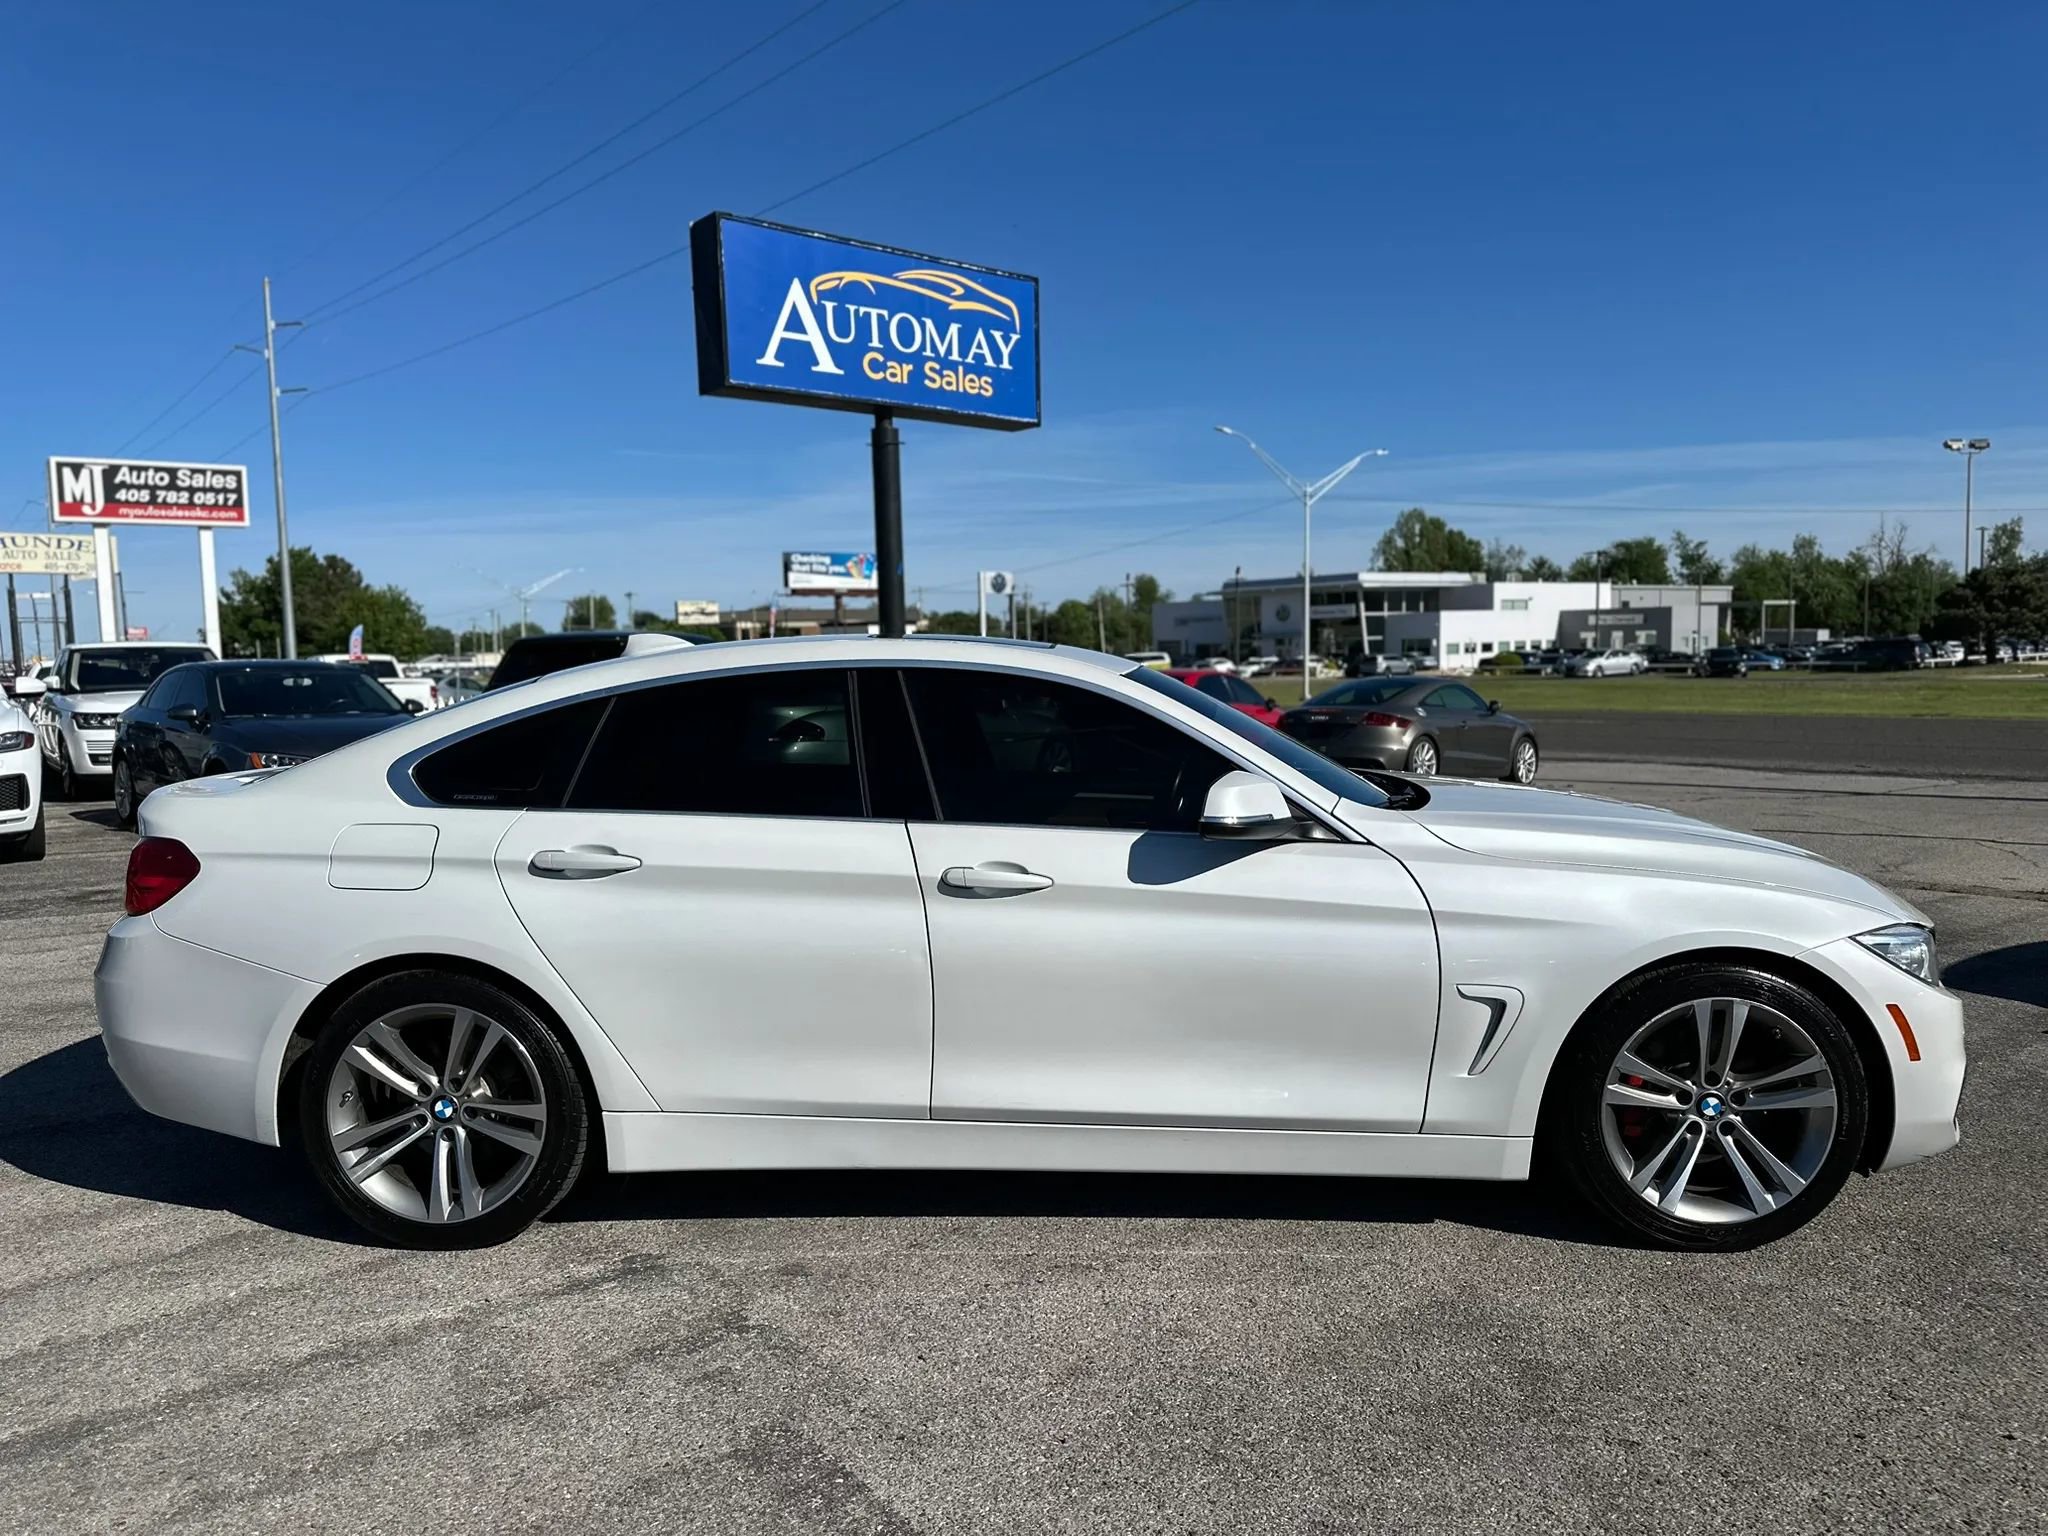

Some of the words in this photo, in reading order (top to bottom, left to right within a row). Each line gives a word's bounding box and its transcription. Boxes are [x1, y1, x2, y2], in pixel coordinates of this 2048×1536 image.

[862, 351, 913, 385] Car
[923, 361, 994, 397] Sales
[113, 466, 170, 487] Auto
[176, 468, 238, 489] Sales
[61, 464, 109, 516] MJ
[115, 488, 150, 503] 405
[155, 490, 190, 505] 782
[192, 491, 238, 506] 0517
[3, 548, 38, 560] AUTO
[44, 550, 81, 562] SALES
